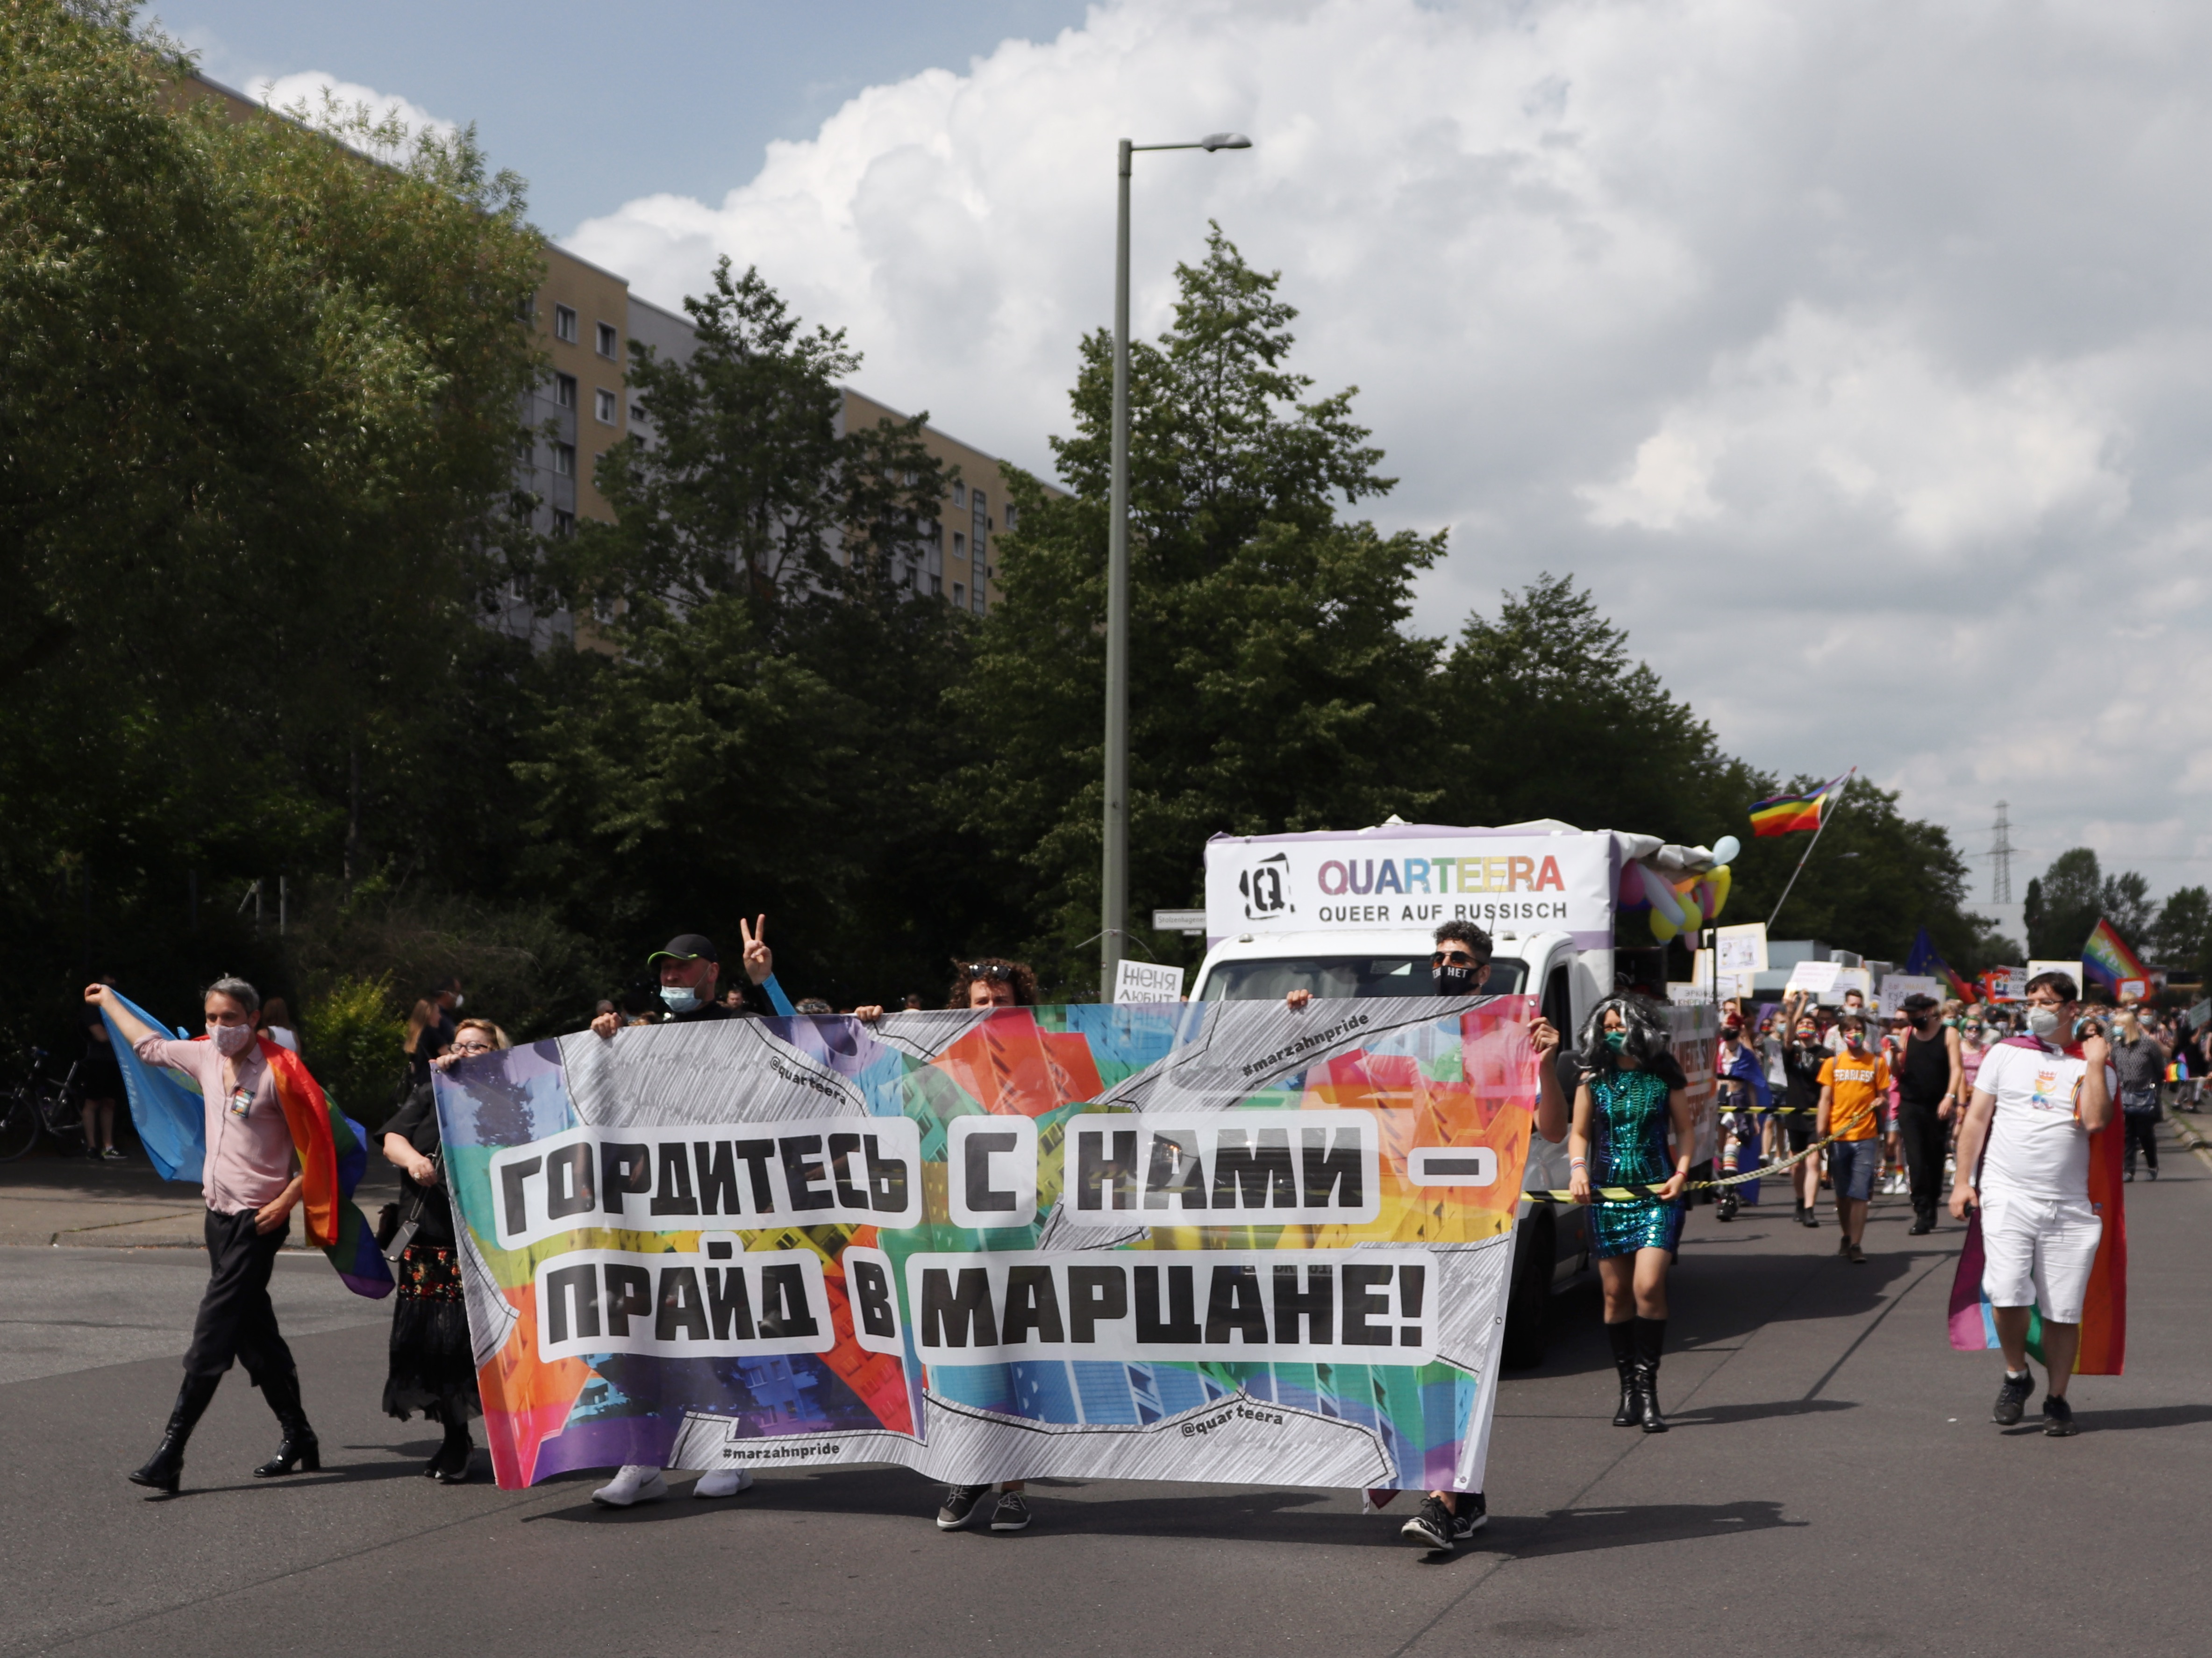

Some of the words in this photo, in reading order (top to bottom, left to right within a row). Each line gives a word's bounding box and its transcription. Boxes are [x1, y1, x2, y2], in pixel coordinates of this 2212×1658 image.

[1318, 855, 1565, 896] QUARTEERA
[1319, 906, 1390, 922] QUEER
[1402, 904, 1443, 921] AUF
[1455, 902, 1567, 920] RUSSISCH
[1242, 1013, 1370, 1077] #marzahnpride
[770, 1056, 846, 1106] @quarteera
[500, 1133, 908, 1236] ГОРДИТЕСЬ
[964, 1132, 1018, 1212] С
[1077, 1127, 1364, 1210] НАМИ
[546, 1241, 820, 1345] ПРАЙД
[852, 1260, 896, 1339] В
[921, 1264, 1426, 1348] МАРЦАНЕ!
[1182, 1404, 1283, 1437] @quarteera
[723, 1443, 840, 1459] #marzahnpride
